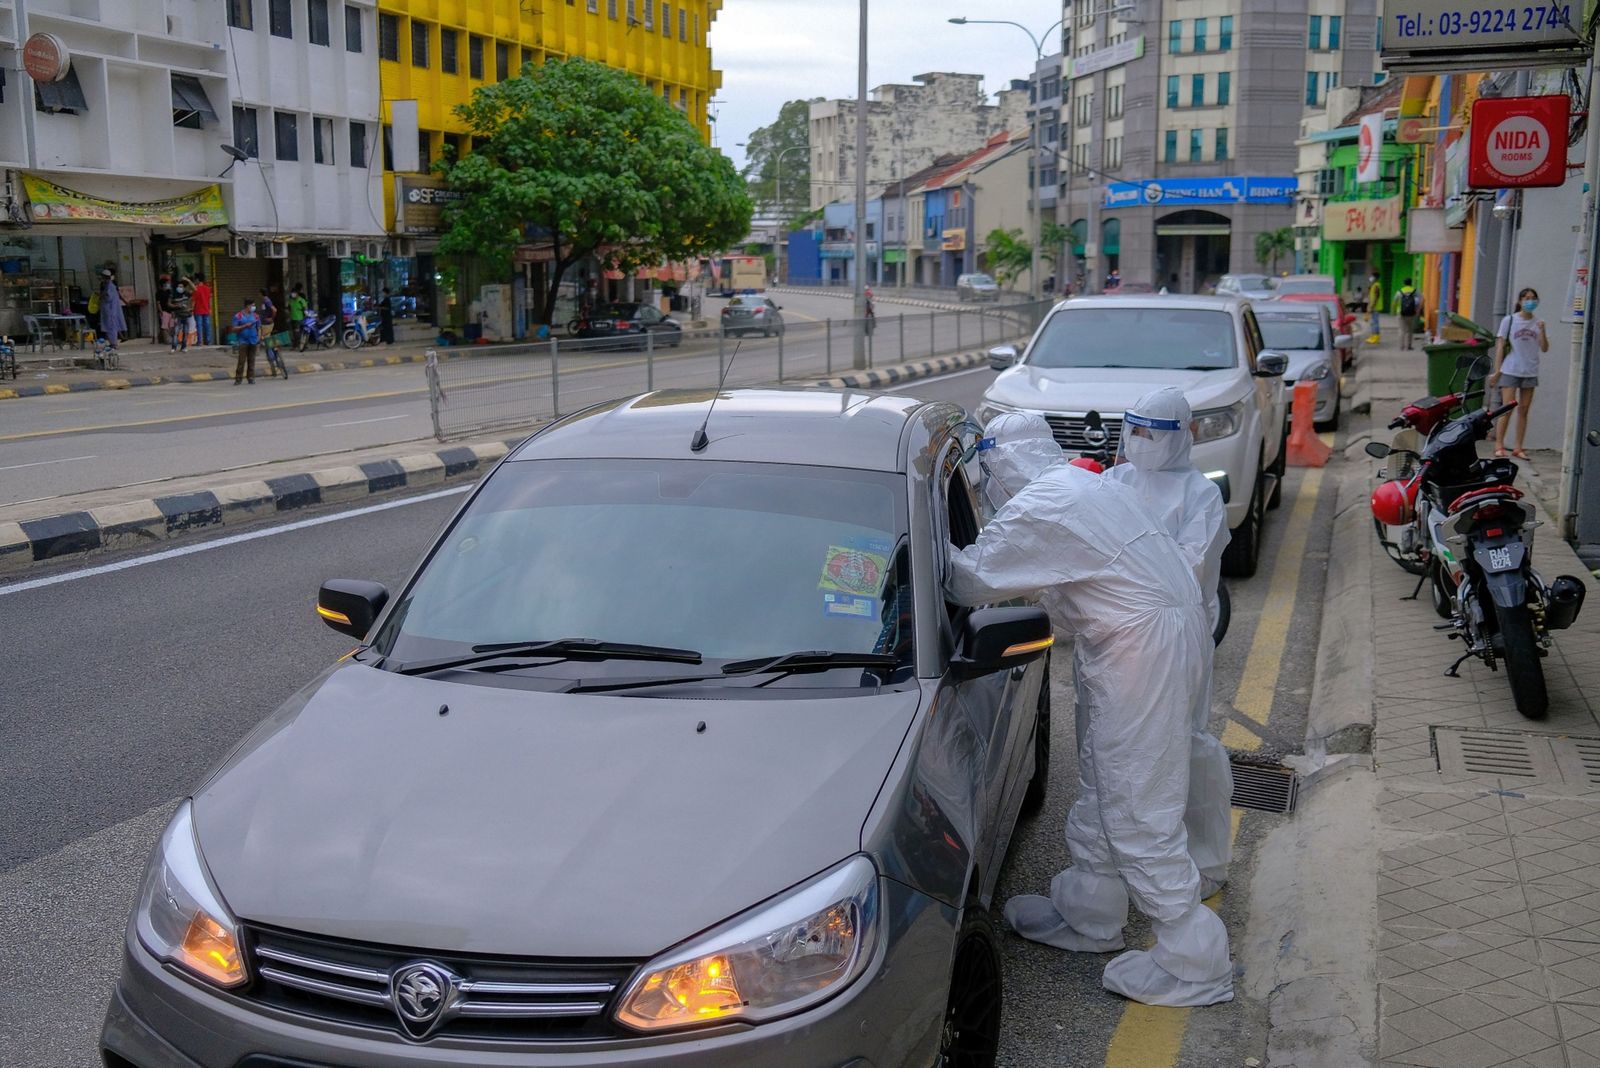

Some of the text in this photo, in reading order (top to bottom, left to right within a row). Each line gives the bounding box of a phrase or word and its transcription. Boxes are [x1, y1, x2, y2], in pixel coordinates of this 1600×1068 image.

[1396, 5, 1571, 37] Tel.: 03-9224 2744
[1495, 130, 1541, 150] NIDA
[1501, 152, 1533, 161] ROOMS
[420, 188, 435, 203] SF
[1198, 187, 1224, 198] HAN
[1489, 547, 1510, 560] RAC
